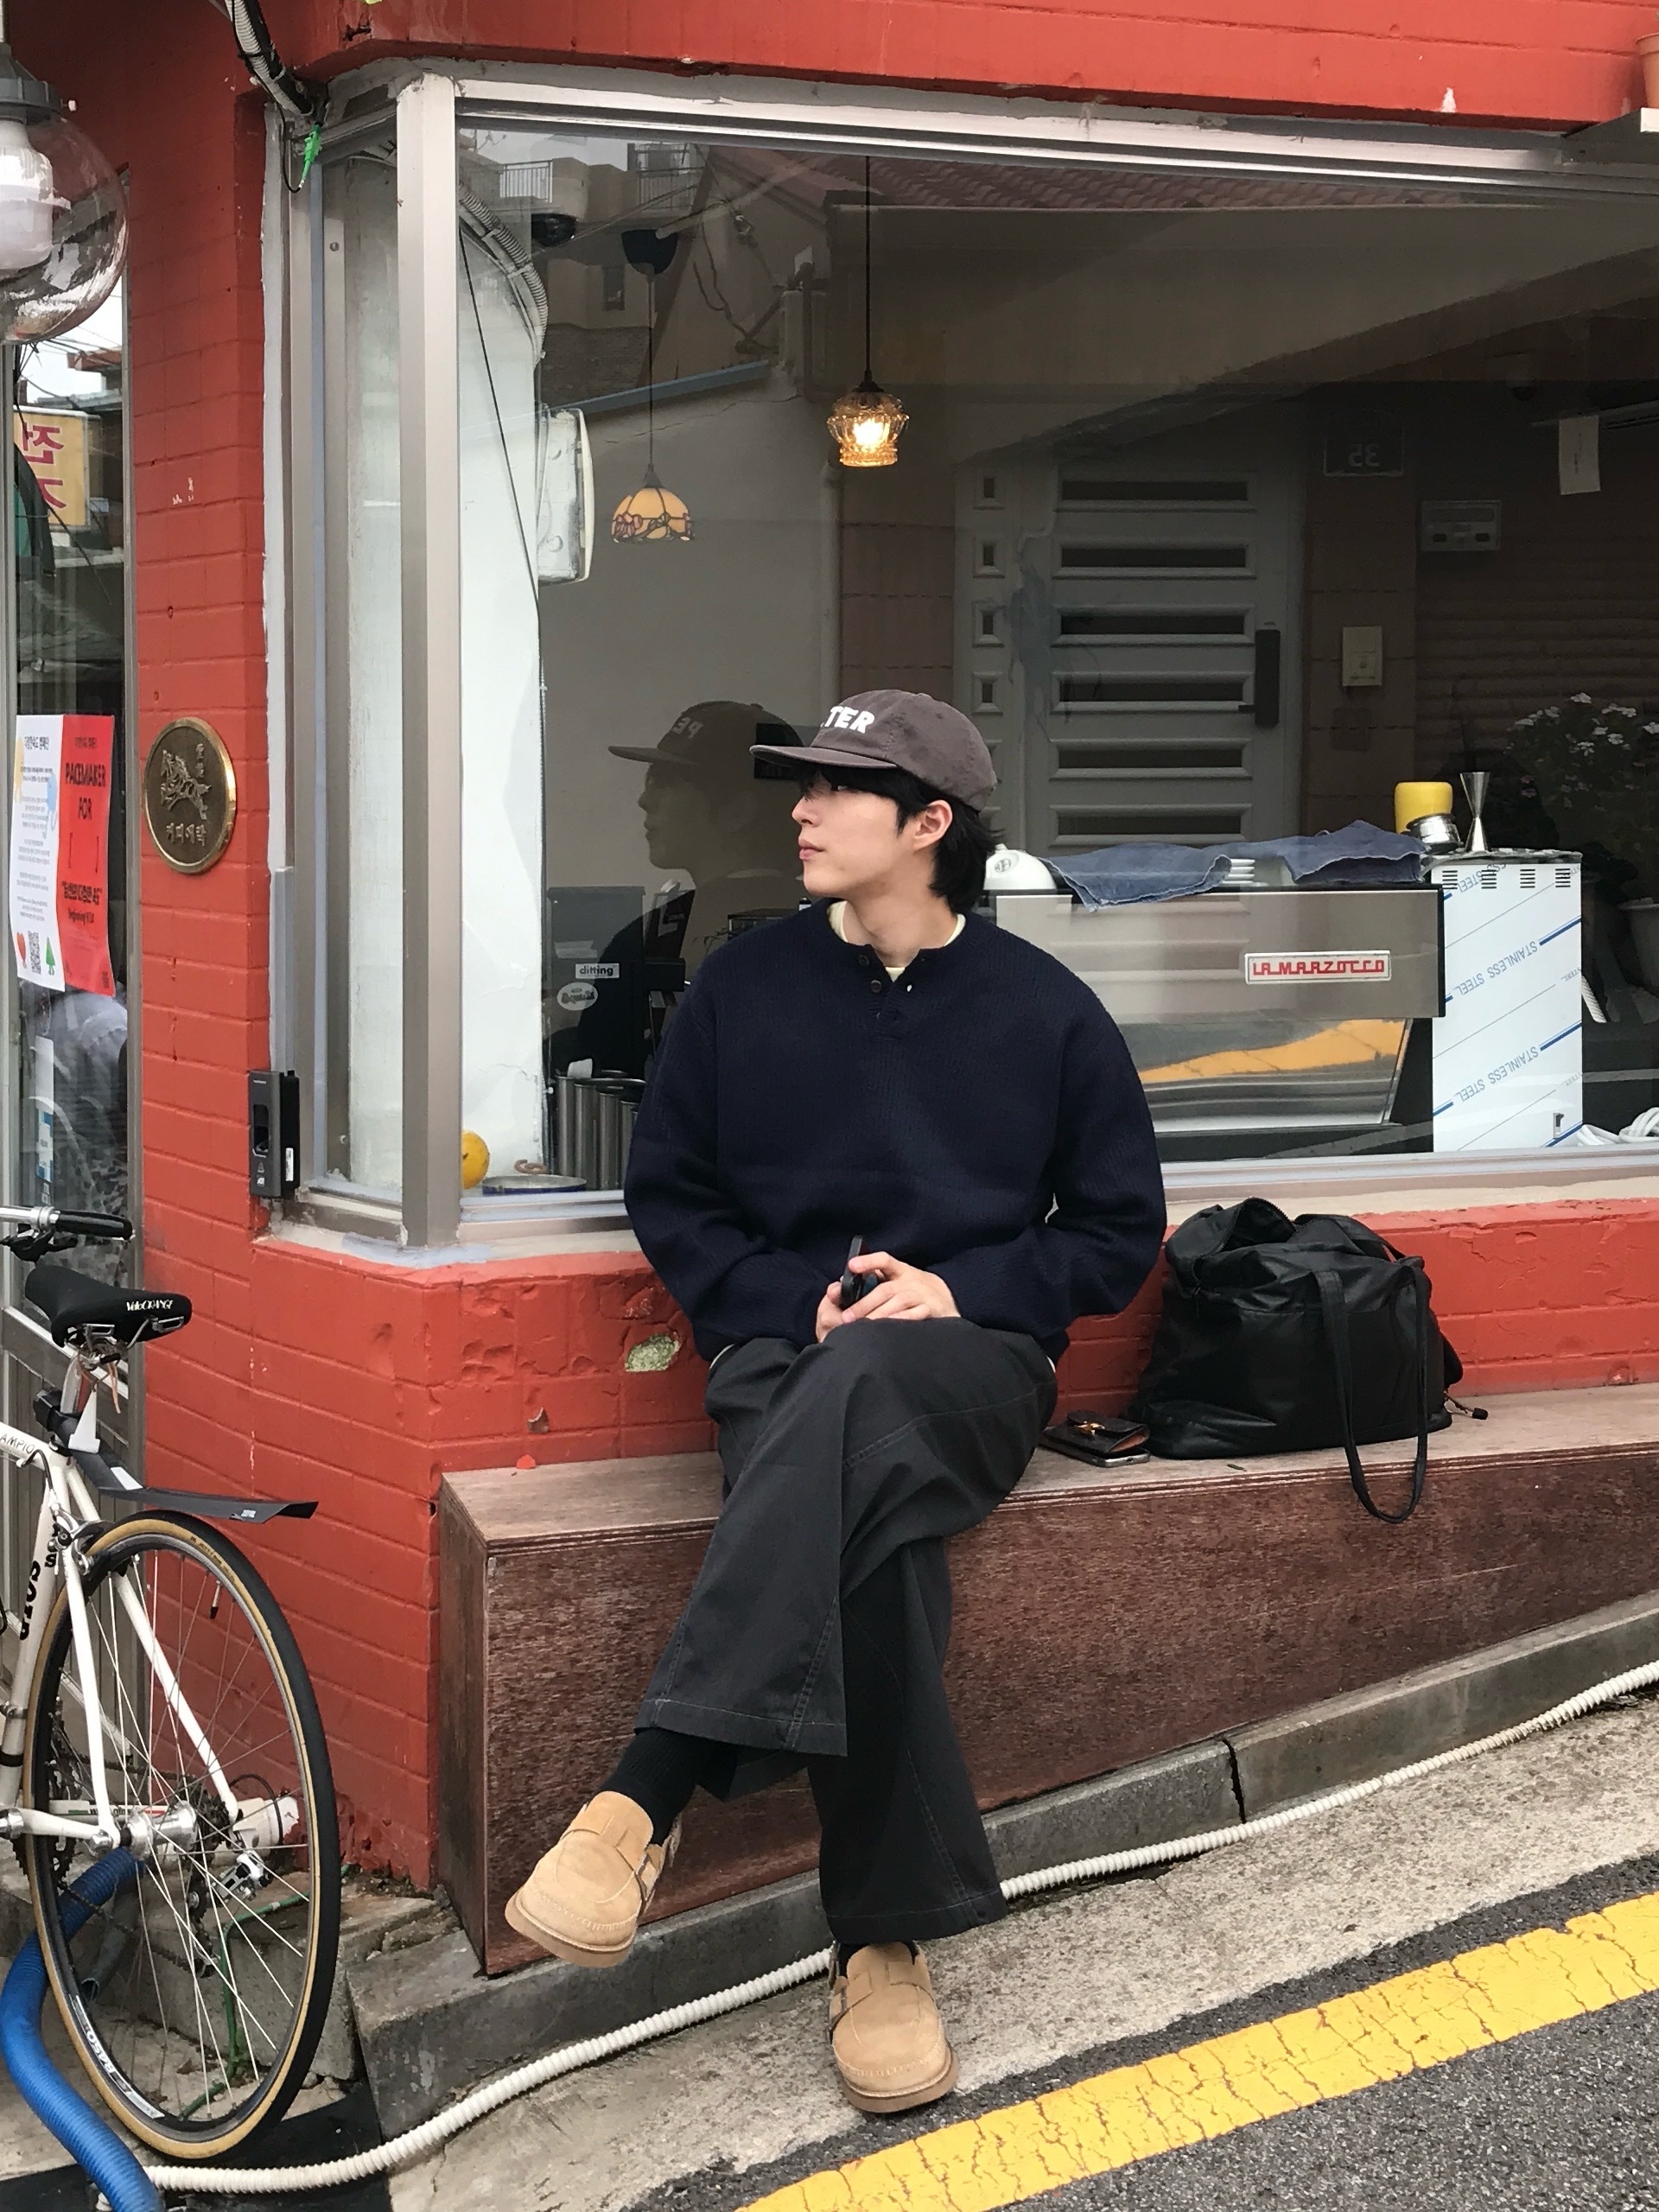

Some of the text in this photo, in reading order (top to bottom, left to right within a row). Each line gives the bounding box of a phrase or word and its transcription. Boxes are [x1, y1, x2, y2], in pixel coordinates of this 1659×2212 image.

[820, 705, 874, 734] TER
[65, 762, 106, 787] PACEMAKER
[78, 797, 92, 820] FOR
[579, 964, 614, 976] ditting
[1253, 962, 1271, 976] LA
[1455, 940, 1538, 997] STAINLESS STEEL
[1455, 1045, 1539, 1103] STAINLESS STEEL
